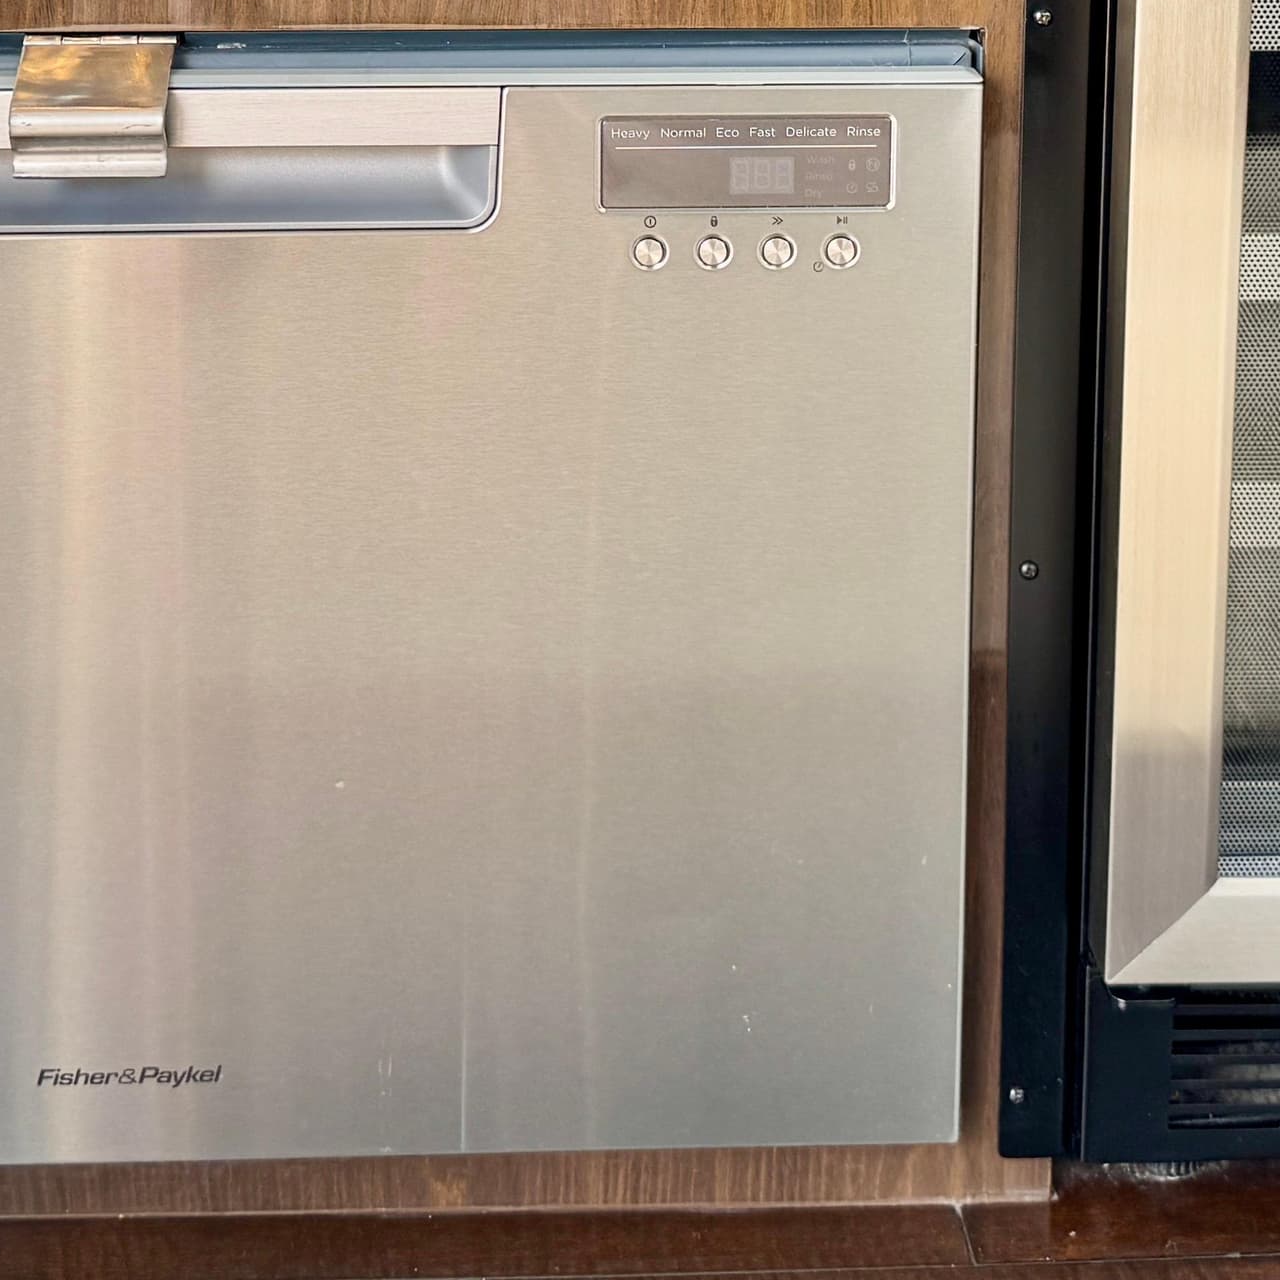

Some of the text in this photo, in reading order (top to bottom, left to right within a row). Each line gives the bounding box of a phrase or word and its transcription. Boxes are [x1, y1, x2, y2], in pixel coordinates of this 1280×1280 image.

[611, 126, 881, 139] Heavy Normal Eco Fast Delicate Rinse
[37, 1064, 222, 1088] Fisher&Paykel
